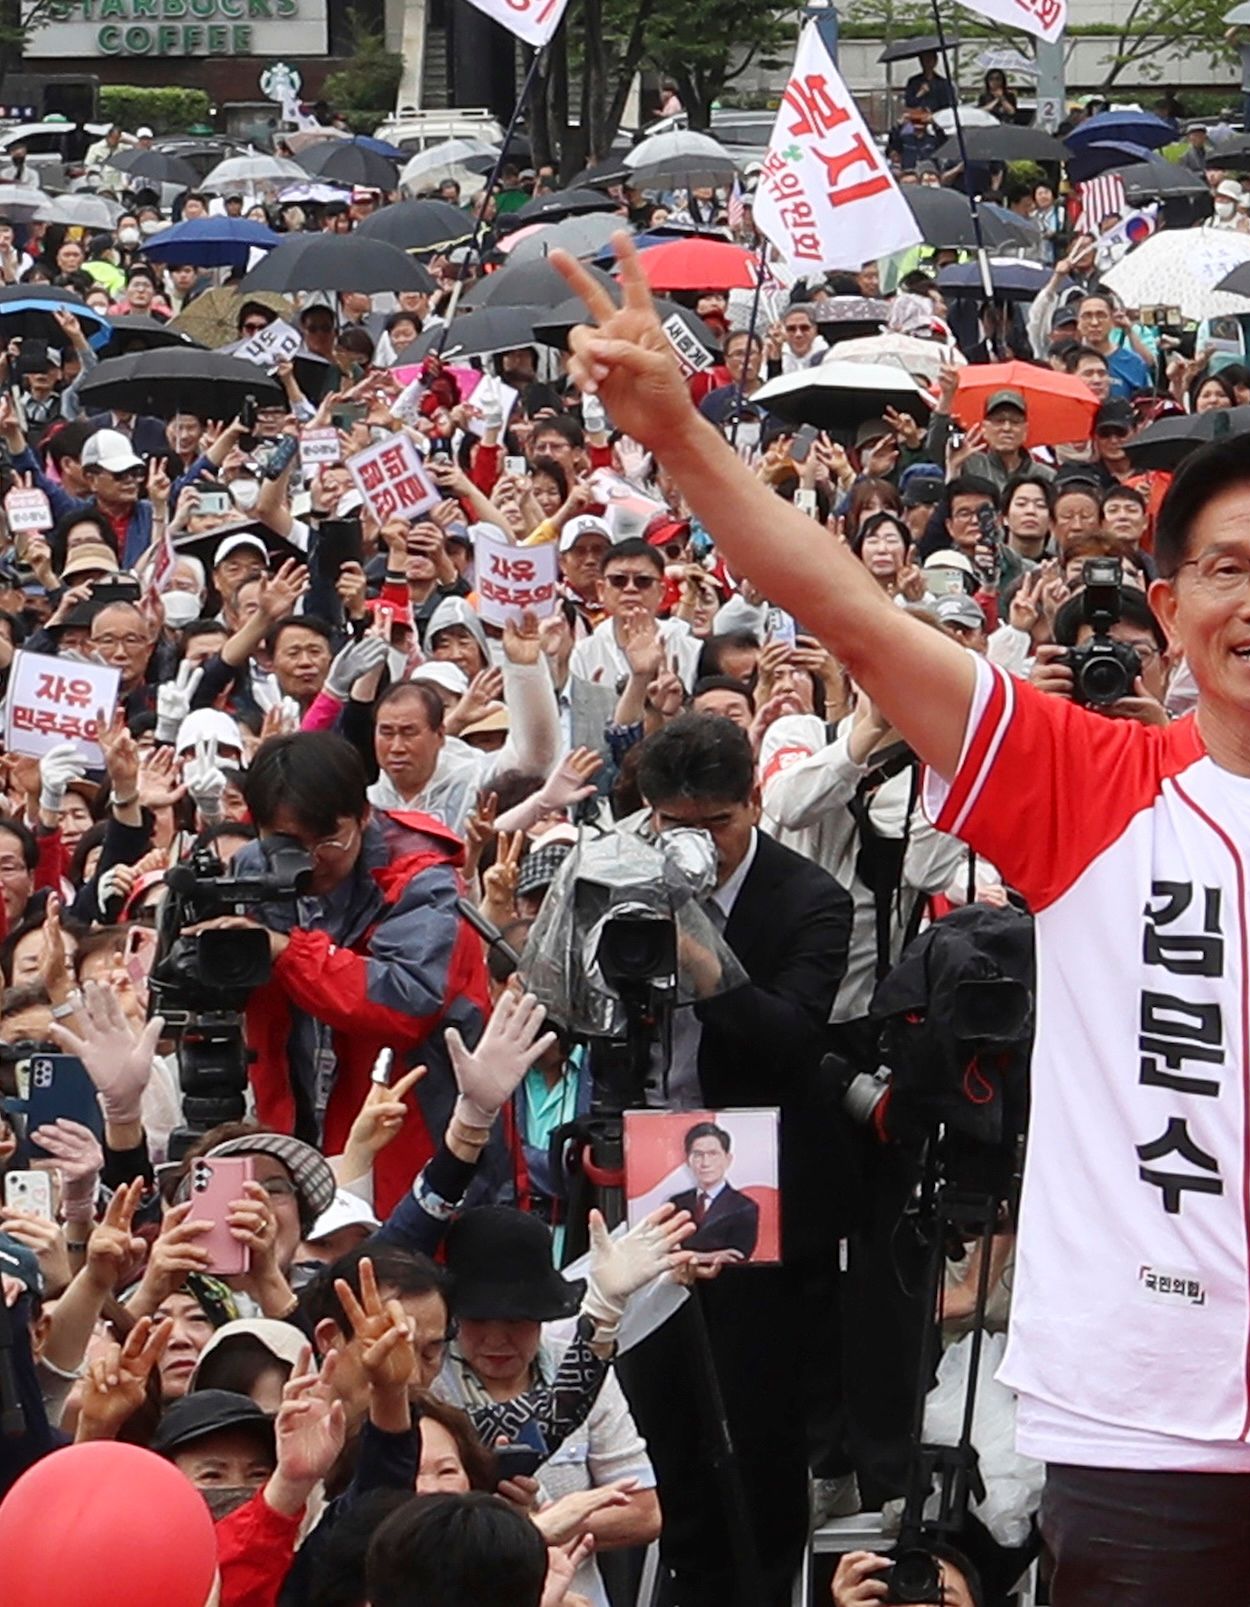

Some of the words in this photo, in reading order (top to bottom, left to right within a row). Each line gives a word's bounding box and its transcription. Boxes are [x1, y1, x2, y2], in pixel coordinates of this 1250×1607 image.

[97, 25, 253, 53] COFFEE
[783, 74, 893, 209] 복지
[488, 553, 536, 583] 자유
[480, 578, 554, 609] 민주주의
[34, 672, 93, 709] 자유
[1134, 880, 1226, 1216] 김문수
